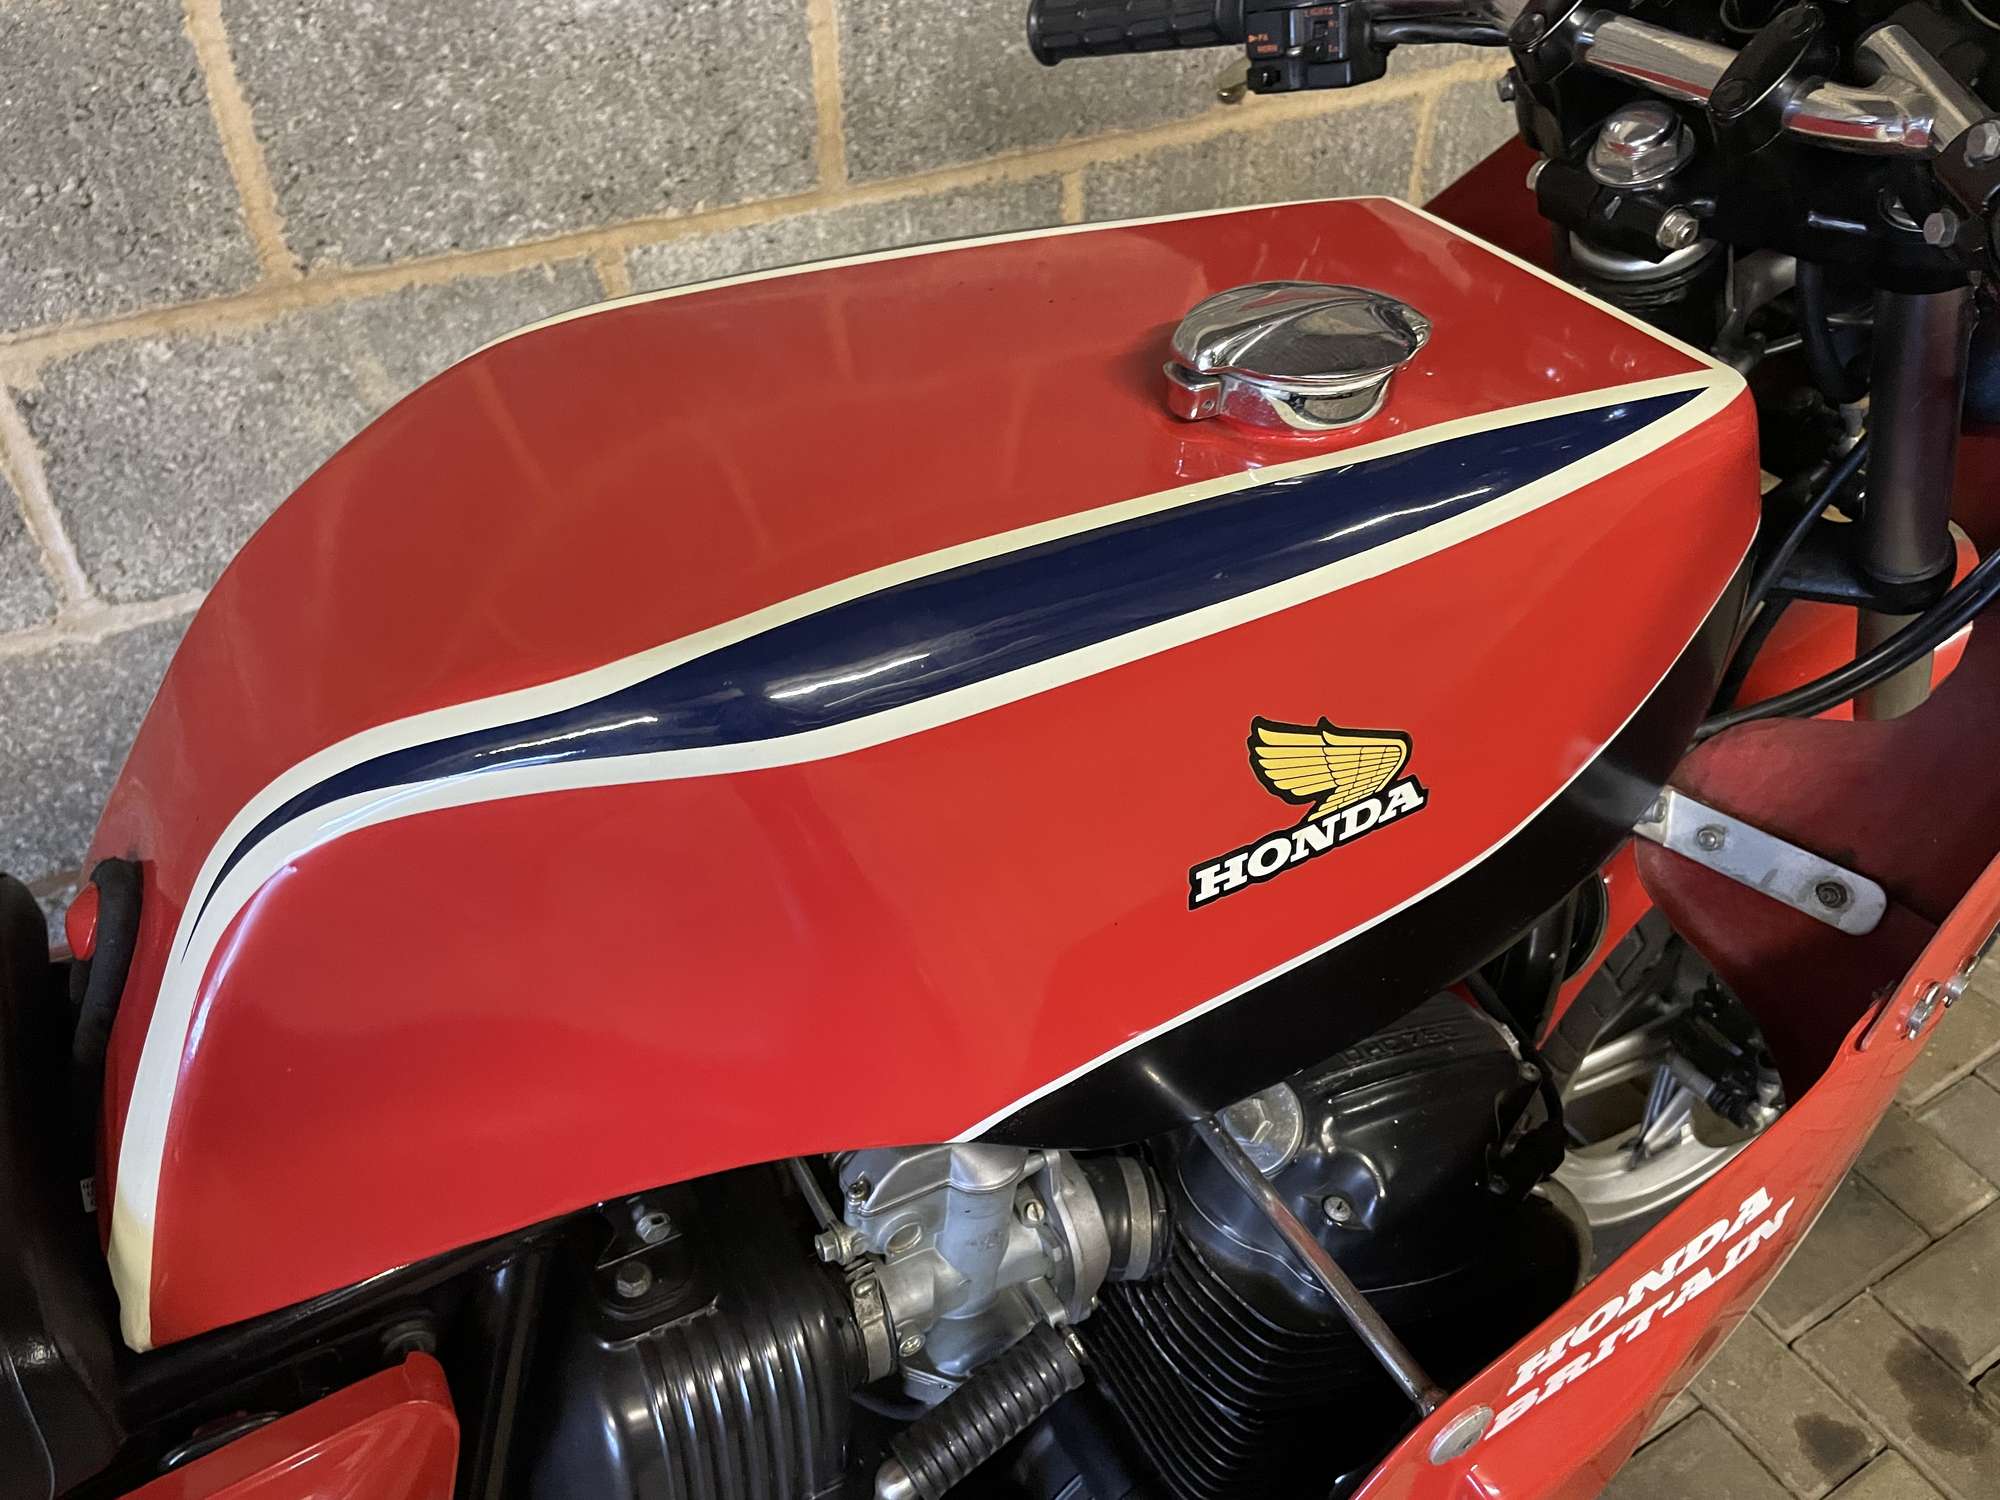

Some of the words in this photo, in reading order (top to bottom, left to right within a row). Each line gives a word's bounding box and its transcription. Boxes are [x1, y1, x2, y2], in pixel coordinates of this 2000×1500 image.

[1195, 781, 1424, 902] HONDA
[1484, 1196, 1795, 1441] BRITAIN
[1507, 1186, 1774, 1396] HONDA
